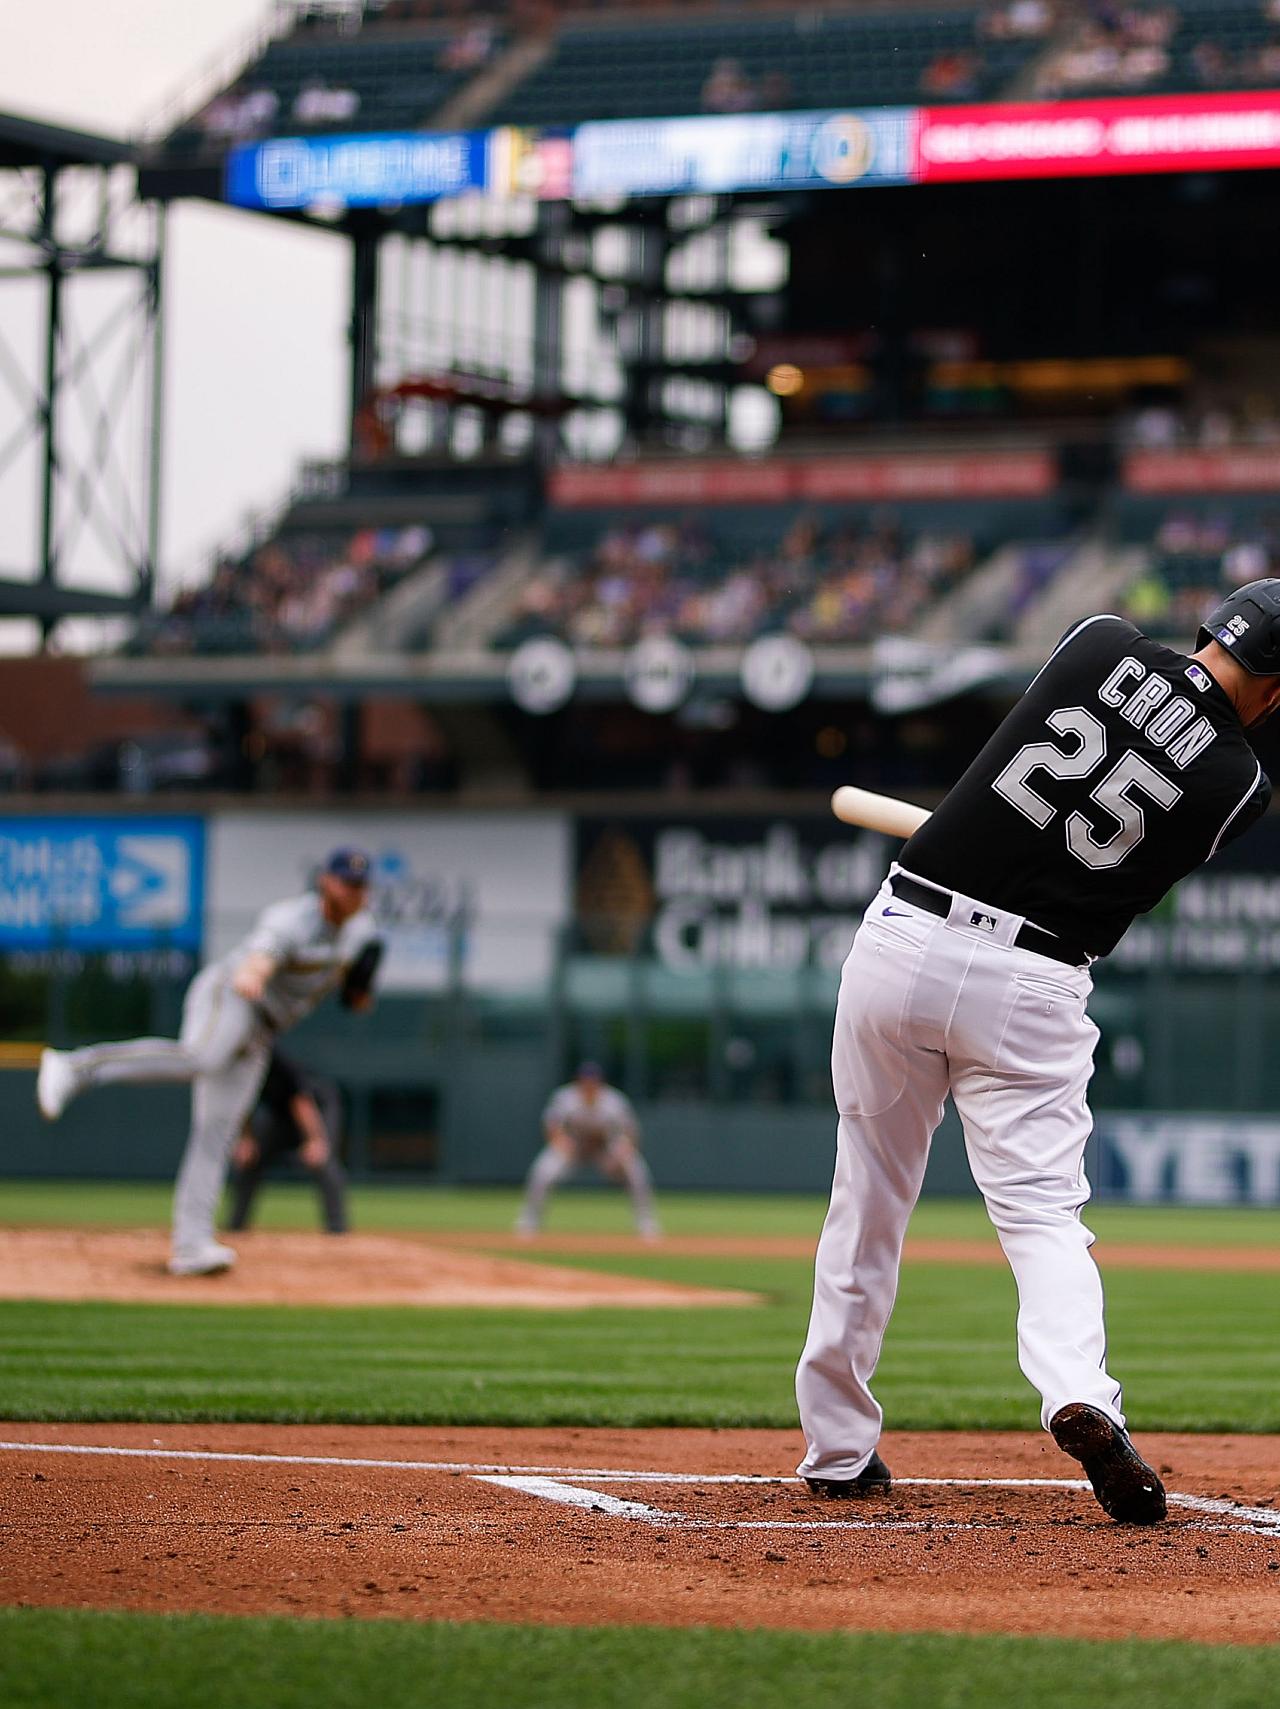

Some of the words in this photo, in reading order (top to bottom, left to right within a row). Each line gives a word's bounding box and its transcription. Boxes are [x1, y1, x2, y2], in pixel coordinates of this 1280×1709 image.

[1226, 614, 1251, 637] 25
[1098, 656, 1217, 770] CRON
[991, 706, 1183, 870] 25
[656, 826, 806, 898] Bank
